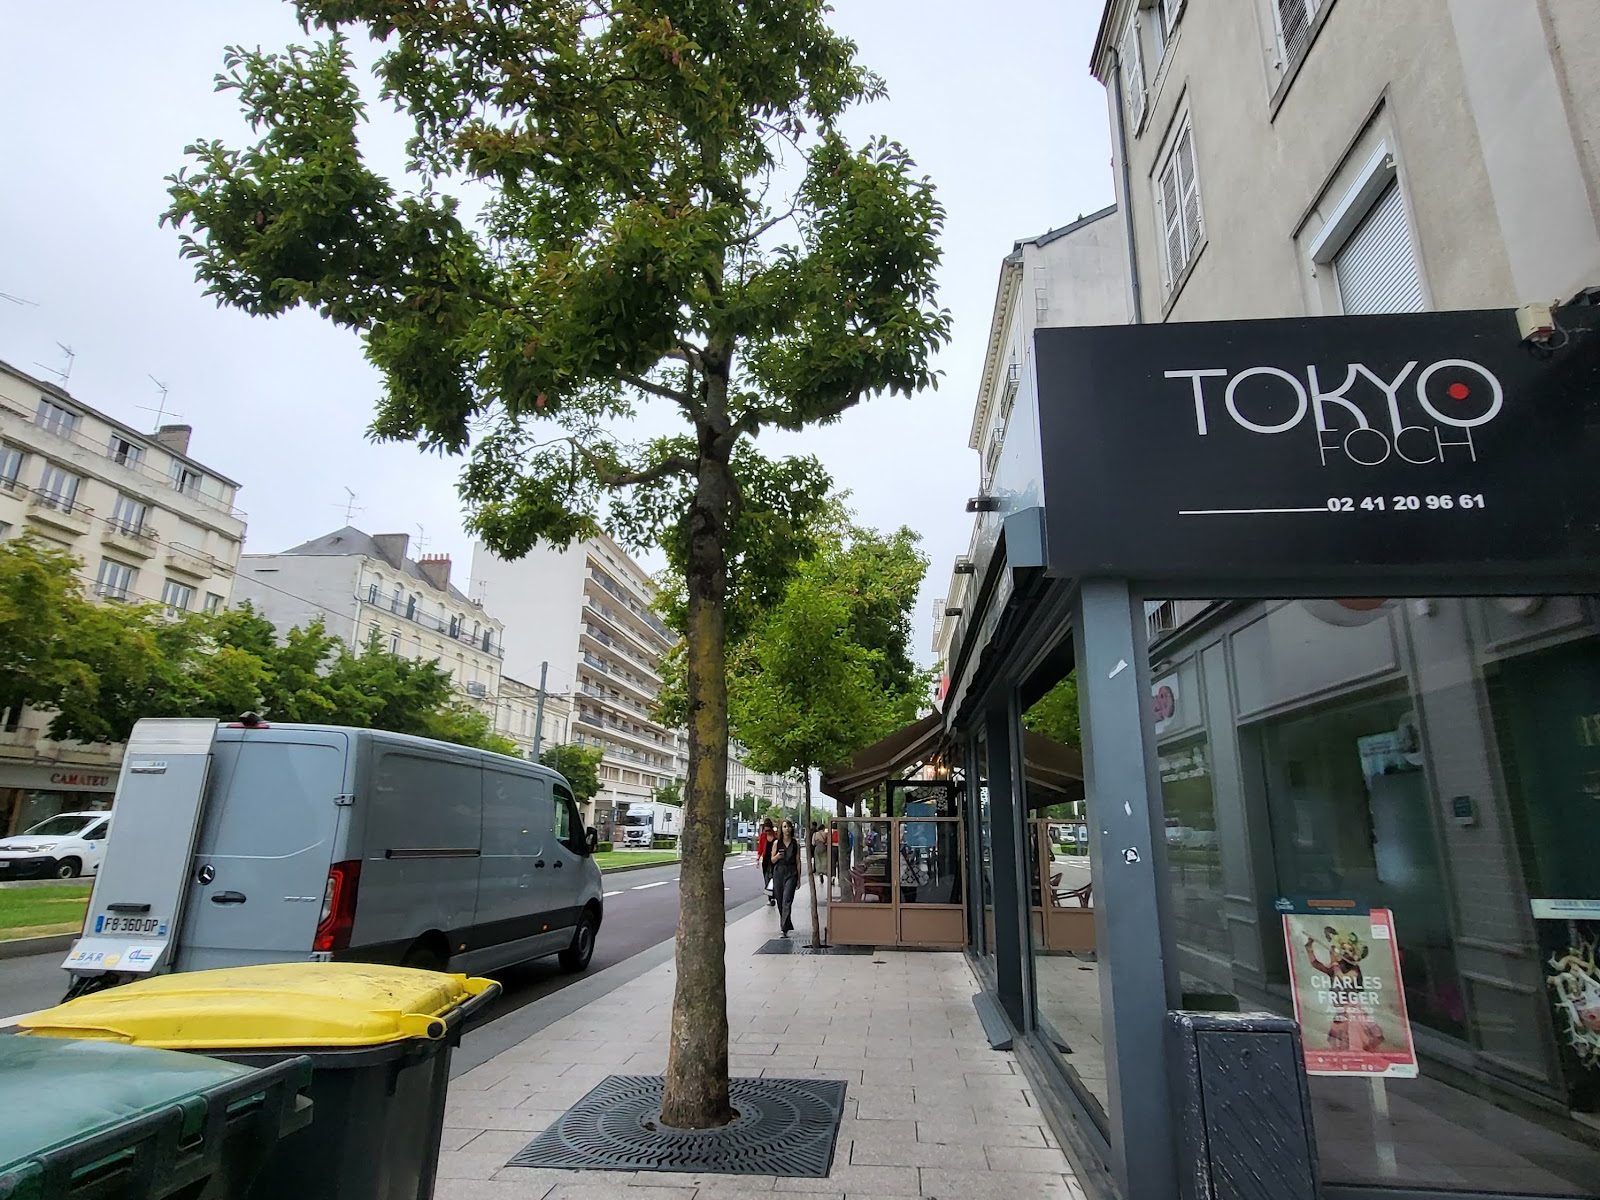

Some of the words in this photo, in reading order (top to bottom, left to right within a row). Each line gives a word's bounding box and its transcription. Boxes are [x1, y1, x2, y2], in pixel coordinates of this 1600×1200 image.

[1164, 358, 1503, 437] TOKYO
[1318, 426, 1477, 467] FOCH
[1327, 496, 1355, 512] 02
[1360, 496, 1386, 511] 41
[1393, 495, 1420, 511] 20
[1425, 494, 1454, 510] 96
[1459, 494, 1486, 509] 61
[1311, 975, 1382, 990] CHARLES
[1318, 991, 1380, 1005] FREGER
